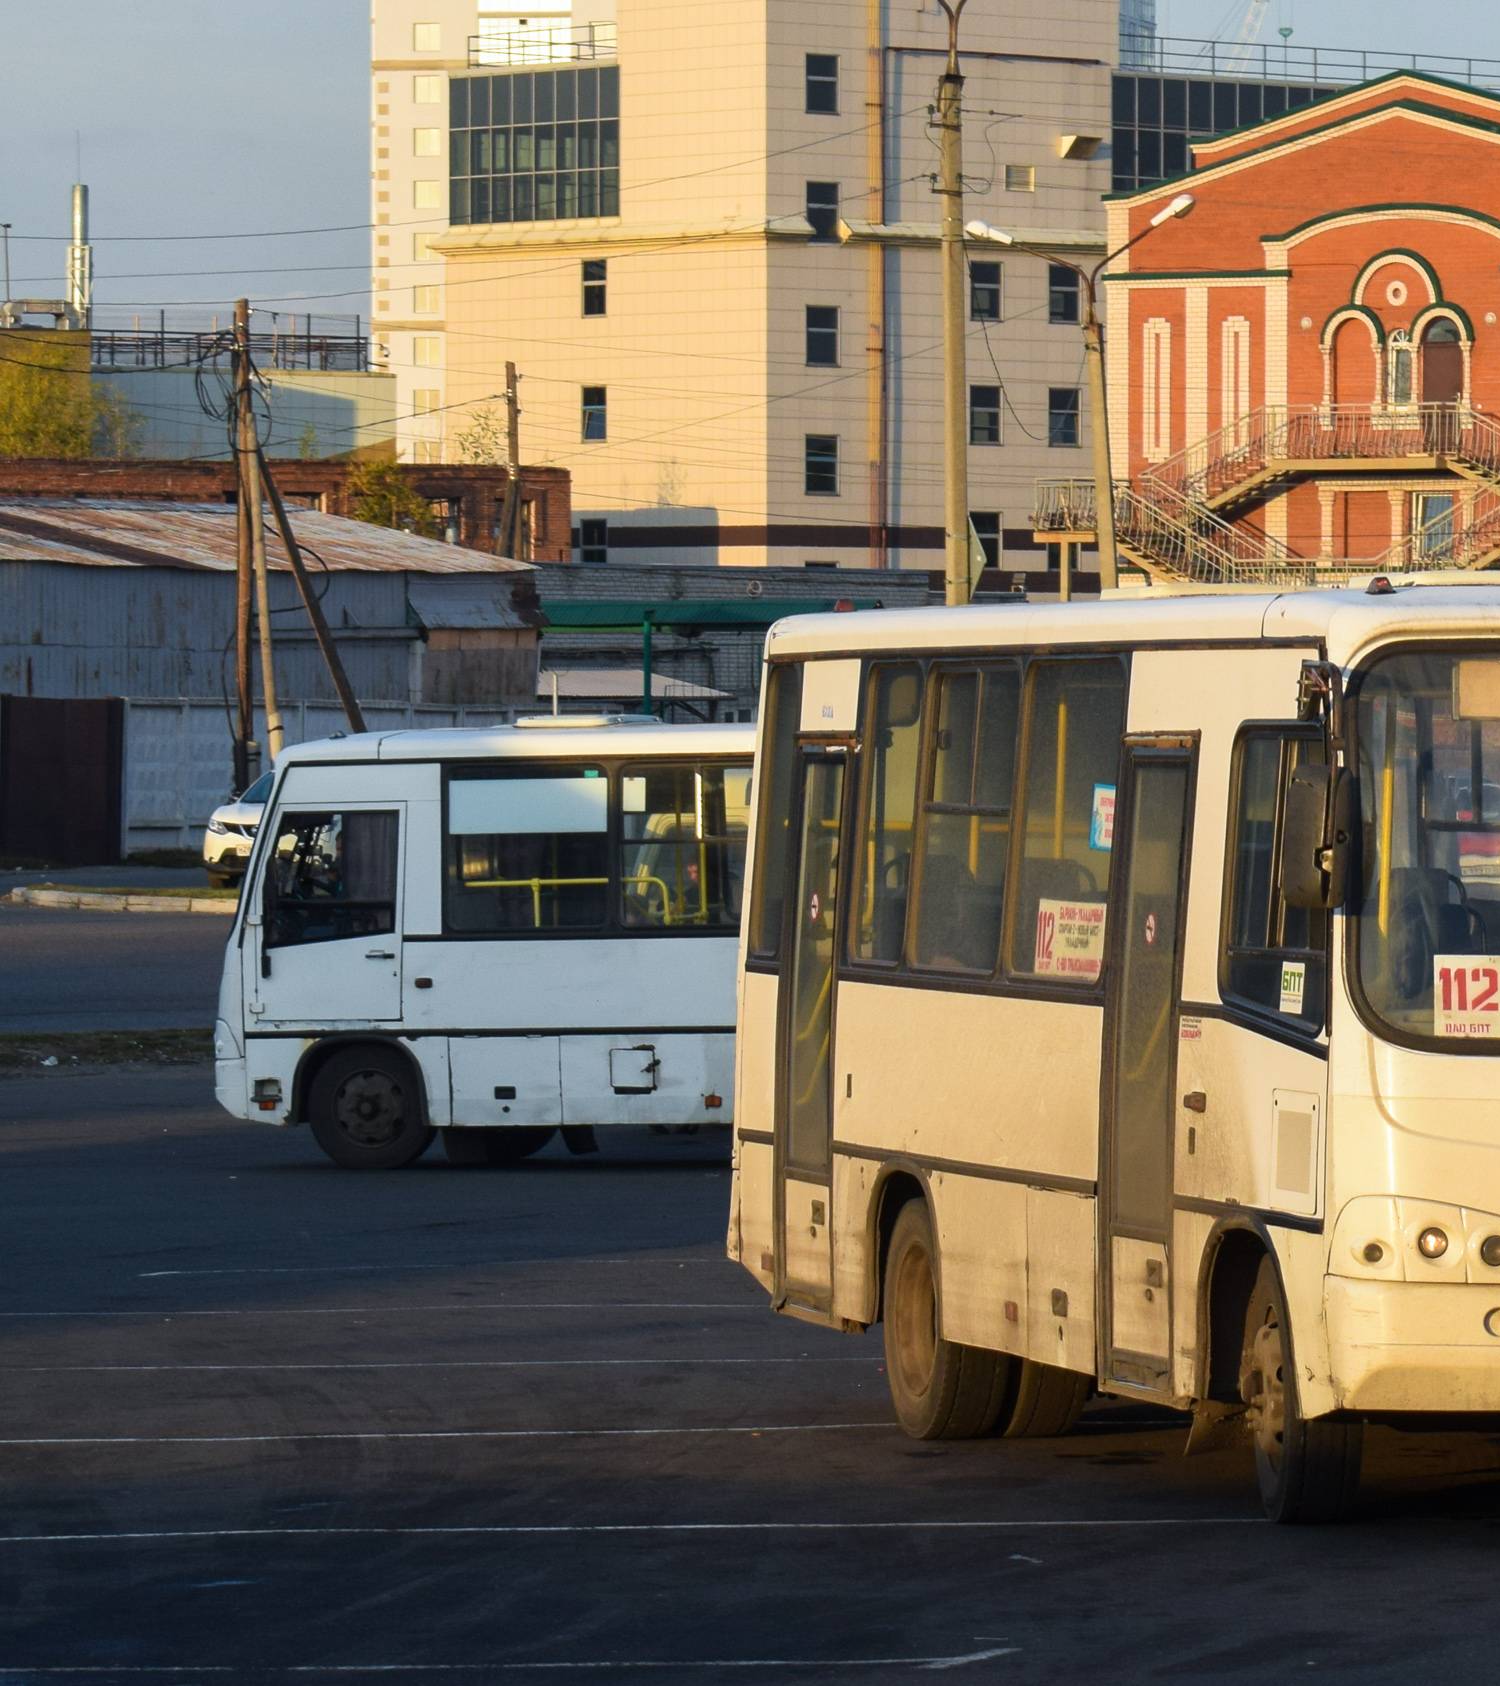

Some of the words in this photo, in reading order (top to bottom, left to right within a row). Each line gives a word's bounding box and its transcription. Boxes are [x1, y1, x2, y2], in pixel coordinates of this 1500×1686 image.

[1037, 910, 1055, 959] 112
[1282, 970, 1303, 992] БПТ
[1439, 967, 1499, 1011] 112
[1445, 1023, 1466, 1033] ОАО
[1469, 1023, 1491, 1033] БПТ
